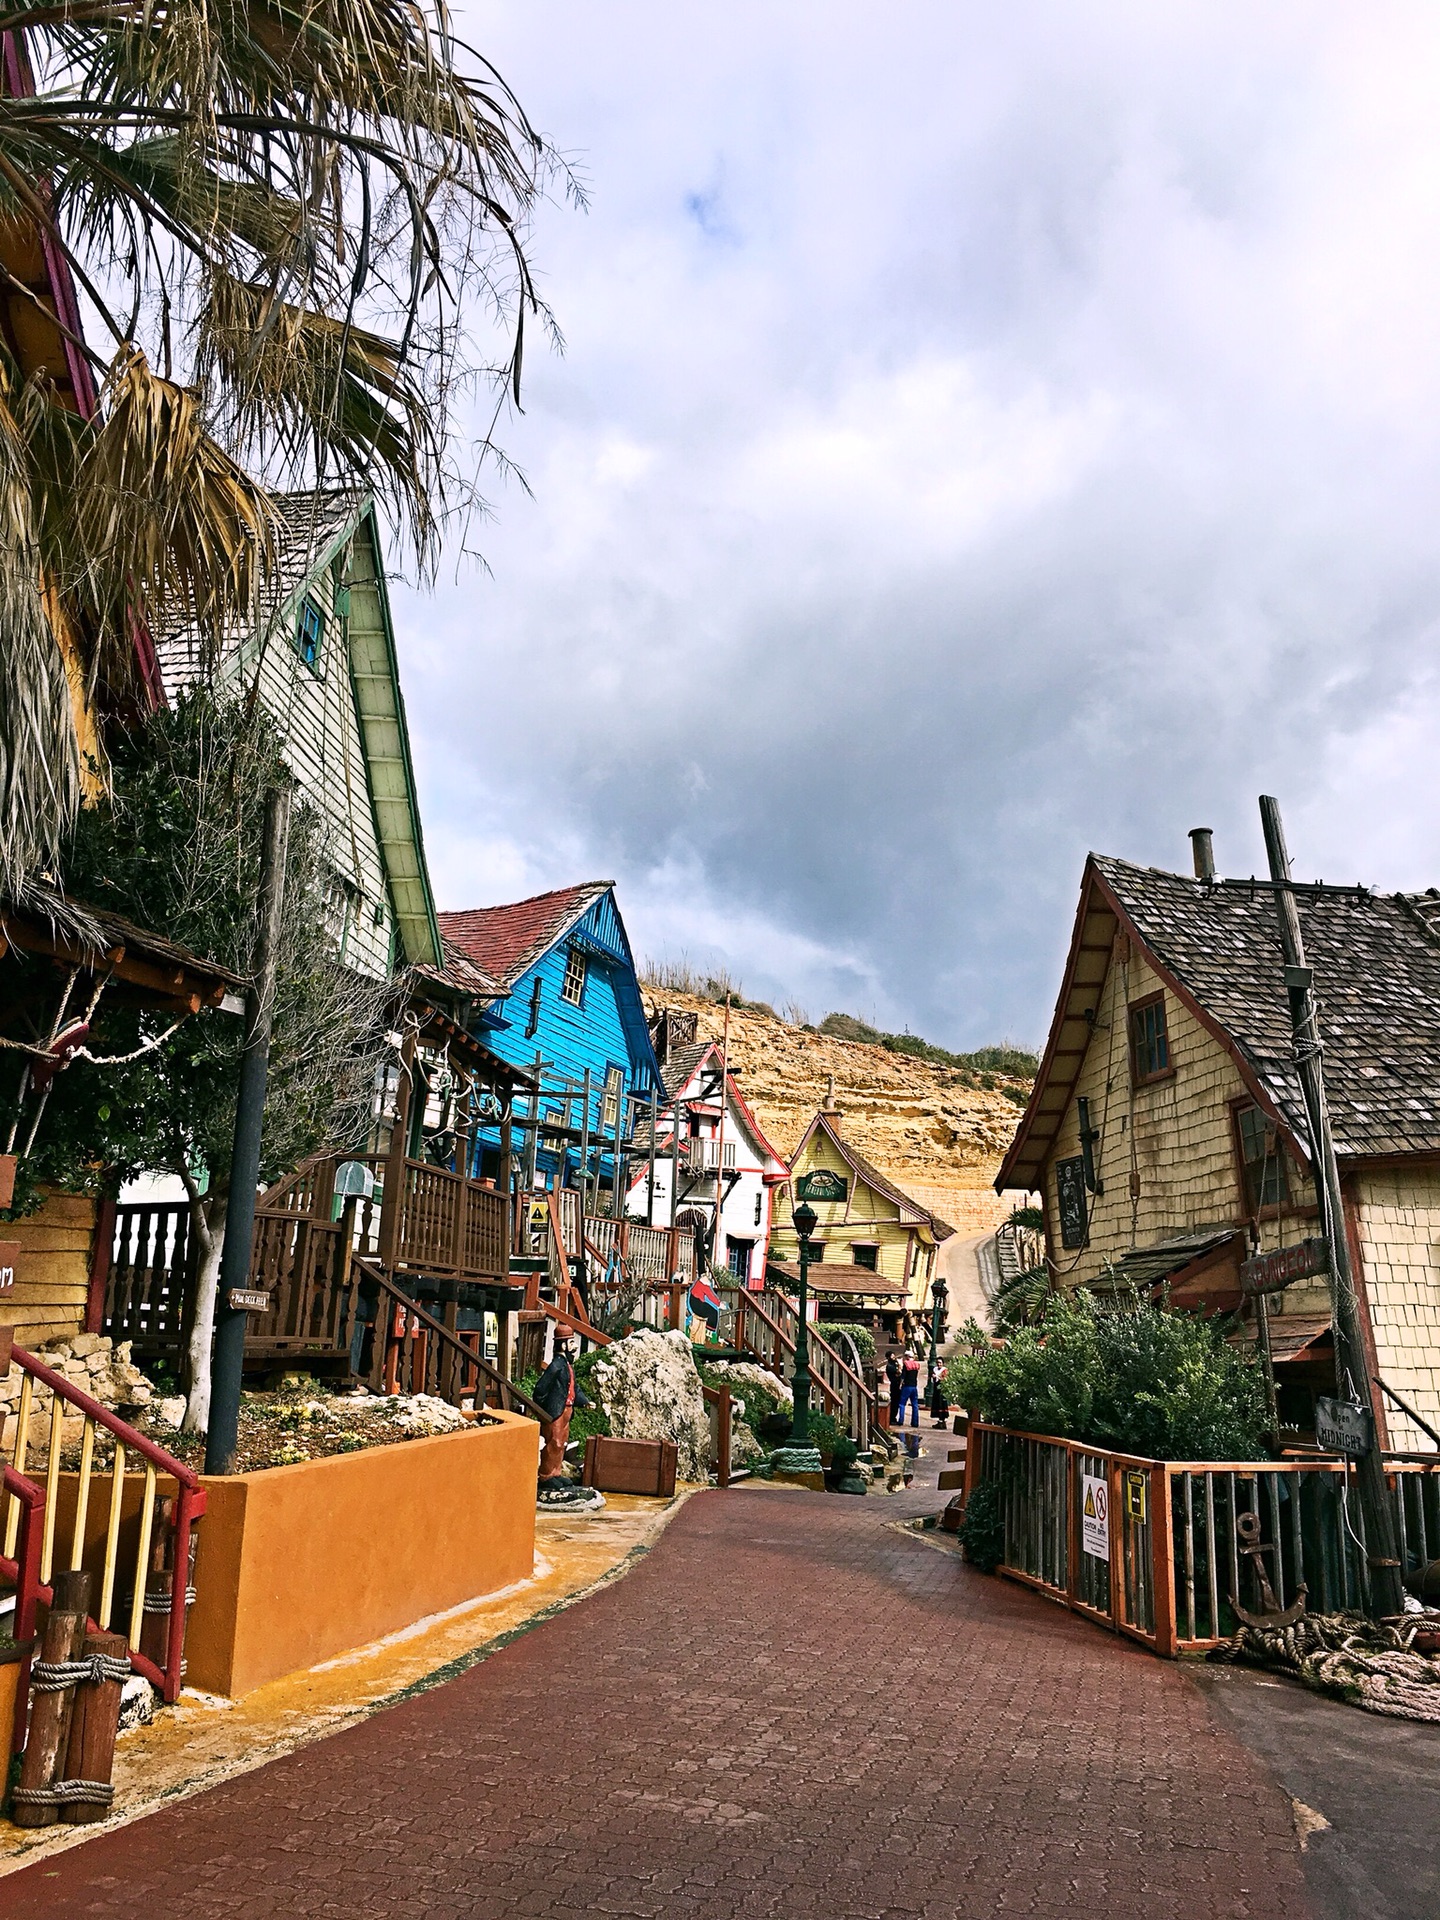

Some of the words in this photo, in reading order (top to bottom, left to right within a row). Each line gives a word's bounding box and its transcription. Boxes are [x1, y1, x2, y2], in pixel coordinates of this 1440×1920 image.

[1253, 1246, 1317, 1289] DUNGEON
[1320, 1427, 1363, 1451] MIDNIGHT
[1084, 1520, 1097, 1531] CAUTION
